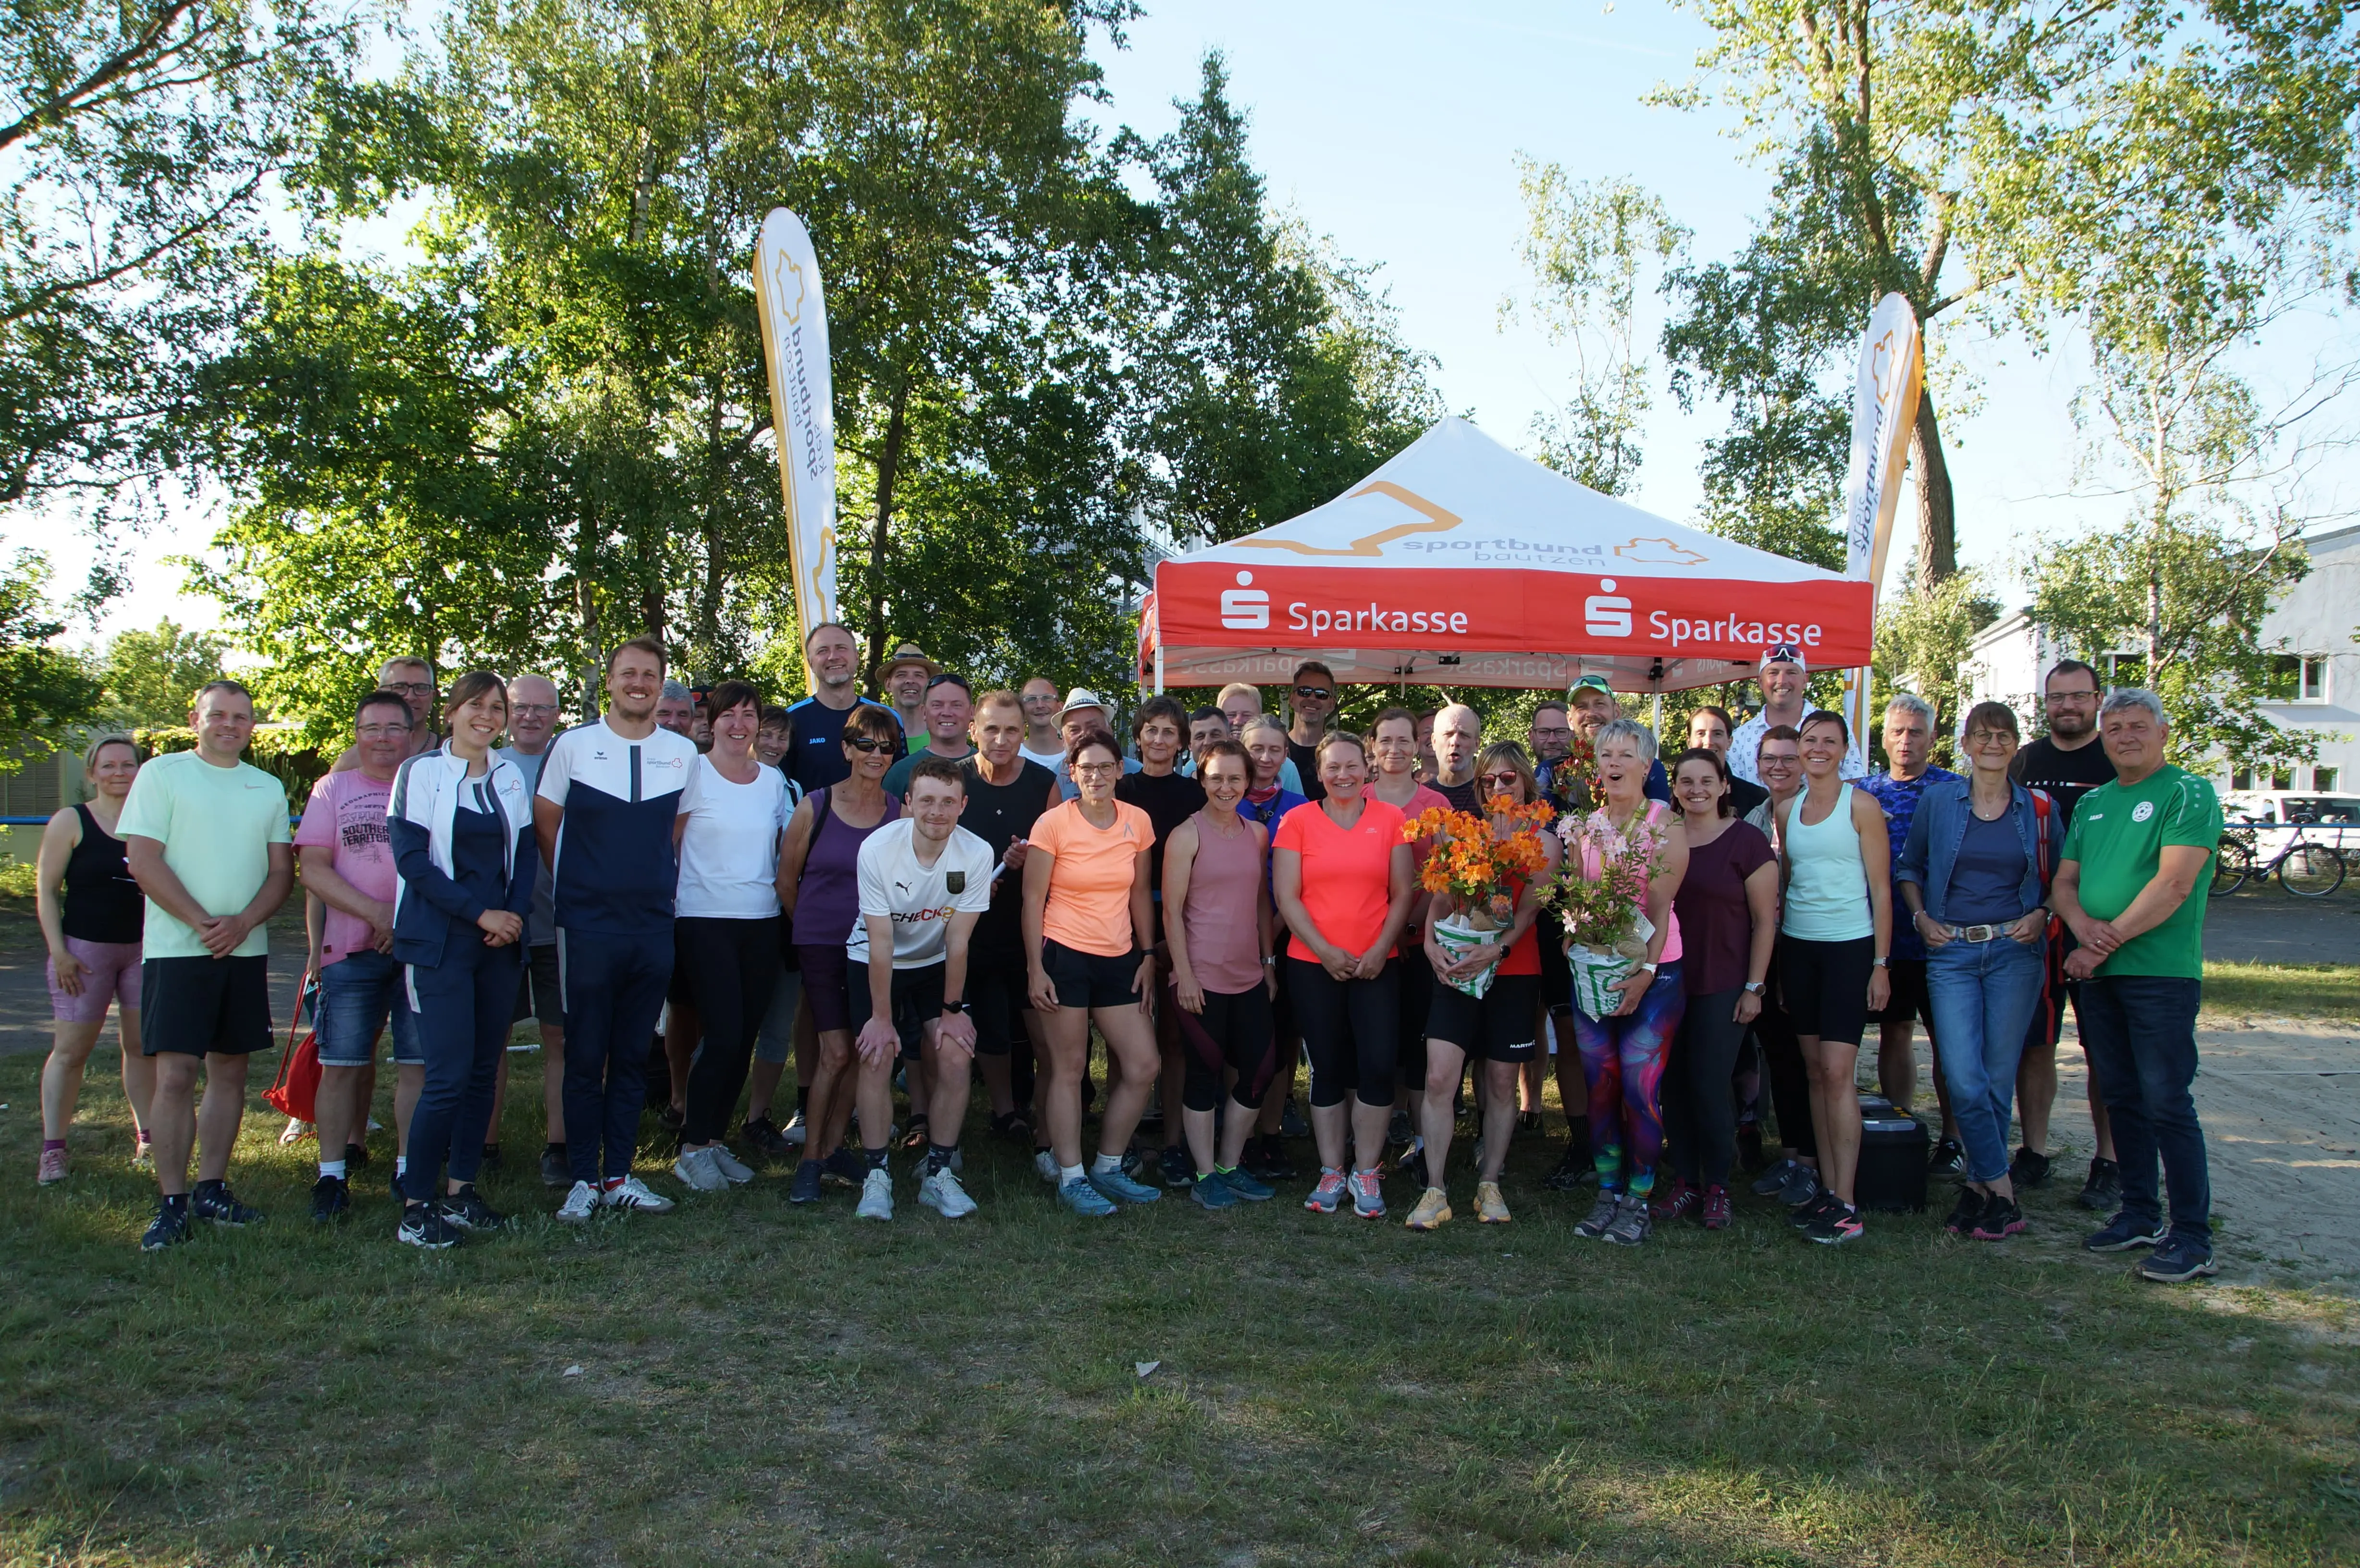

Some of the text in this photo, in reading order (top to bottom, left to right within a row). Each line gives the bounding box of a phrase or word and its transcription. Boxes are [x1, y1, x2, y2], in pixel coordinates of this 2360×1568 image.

[1860, 403, 1883, 557] sportbund
[1402, 538, 1602, 556] sportbund
[1474, 551, 1606, 566] bautzen
[1288, 602, 1468, 637] Sparkasse
[1649, 610, 1822, 647] Sparkasse
[340, 792, 391, 810] GEOGRAPHICA
[338, 811, 387, 826] EXPLO
[342, 823, 390, 837] SOUTHER
[342, 834, 390, 847] TERRITOR
[890, 906, 956, 923] CHECK2
